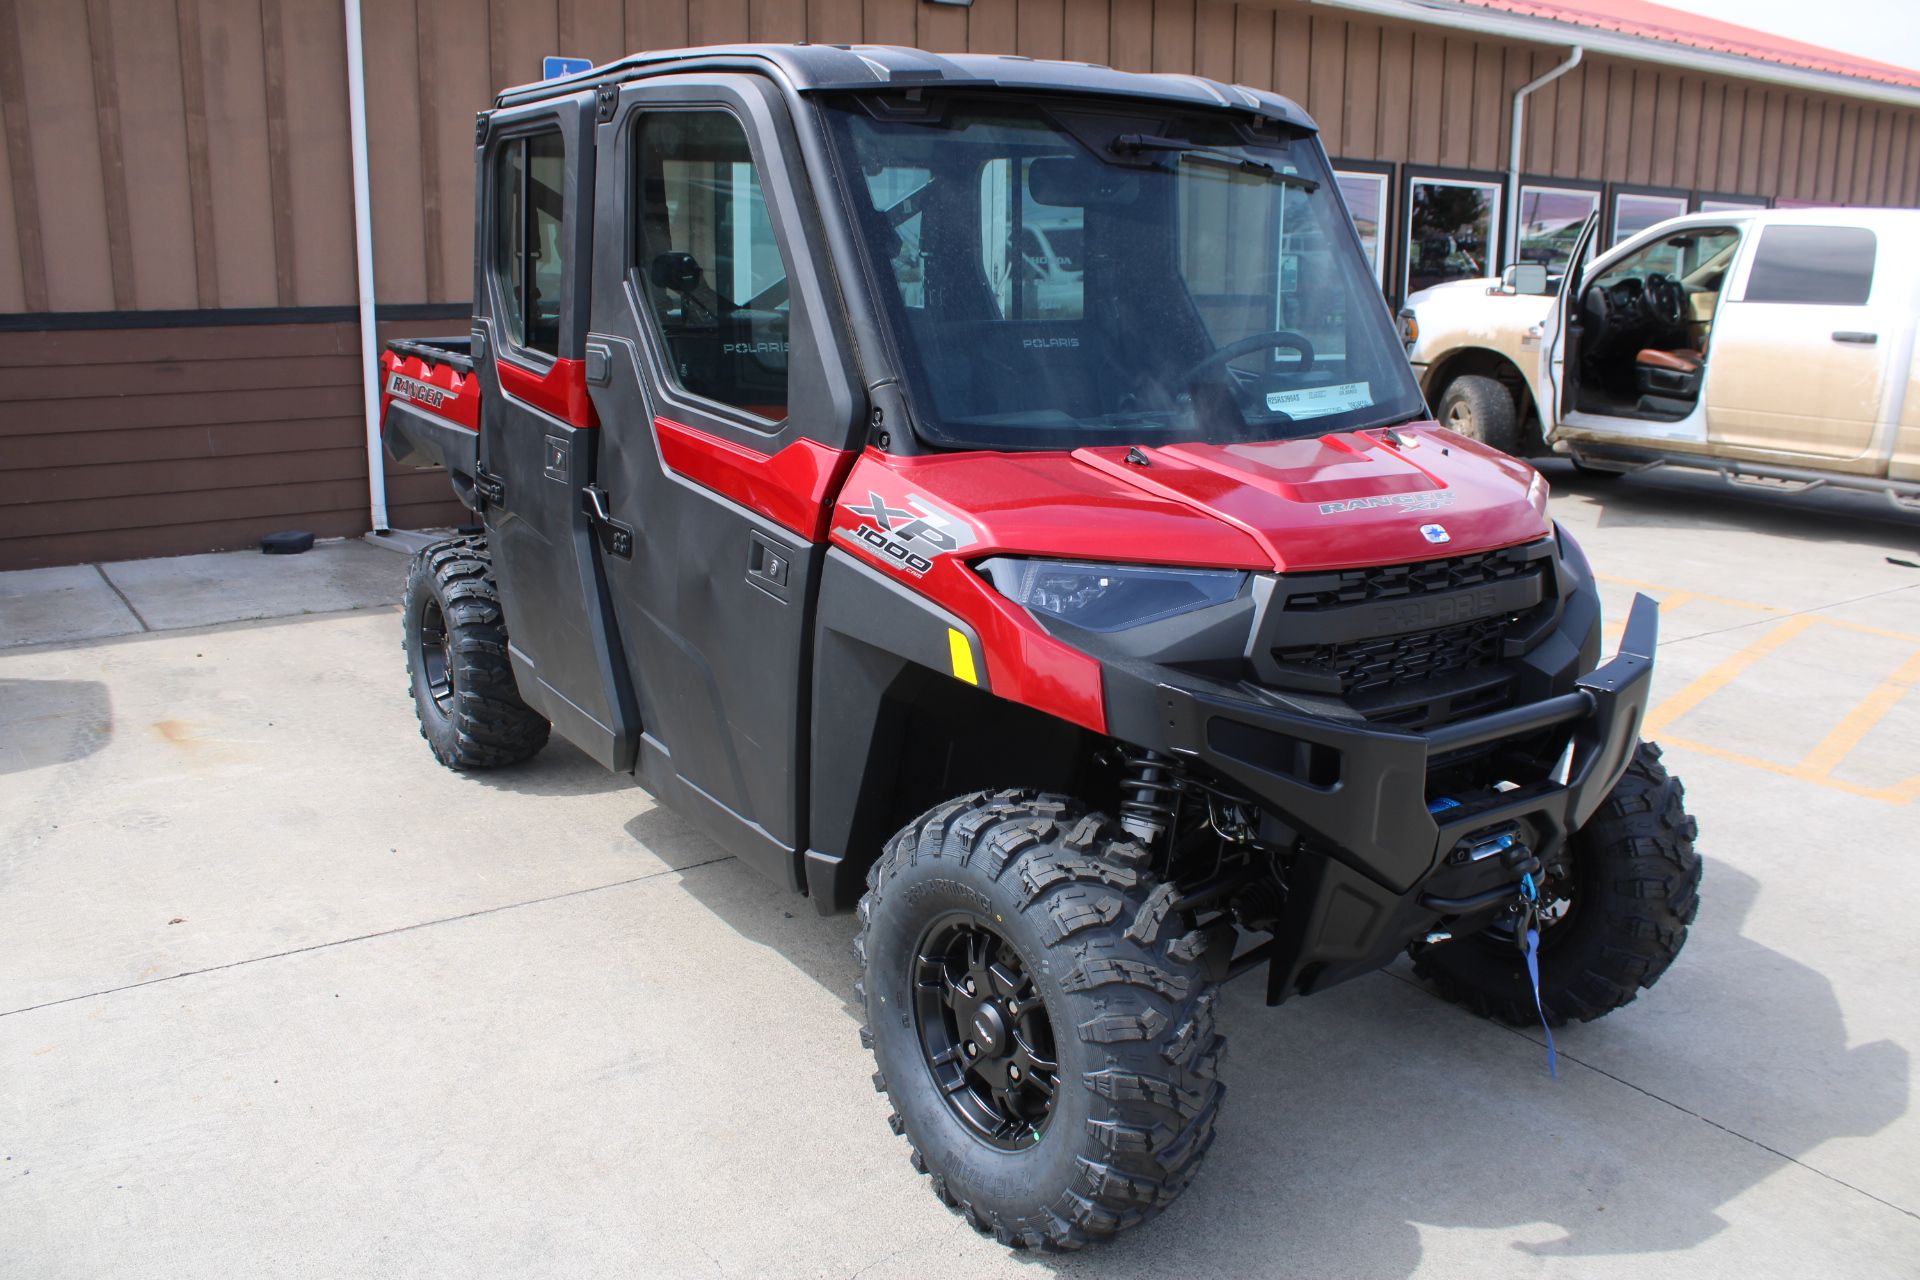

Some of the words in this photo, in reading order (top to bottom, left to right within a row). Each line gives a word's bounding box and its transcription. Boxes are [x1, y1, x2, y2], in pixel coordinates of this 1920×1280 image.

[1031, 256, 1073, 266] HODA
[723, 342, 789, 354] POLARIS
[1022, 338, 1081, 349] POLARIS
[392, 376, 445, 409] RANGER
[1318, 492, 1456, 514] RANGER
[841, 490, 958, 551] XP
[857, 524, 934, 574] 1000
[1374, 587, 1496, 630] POLARIS
